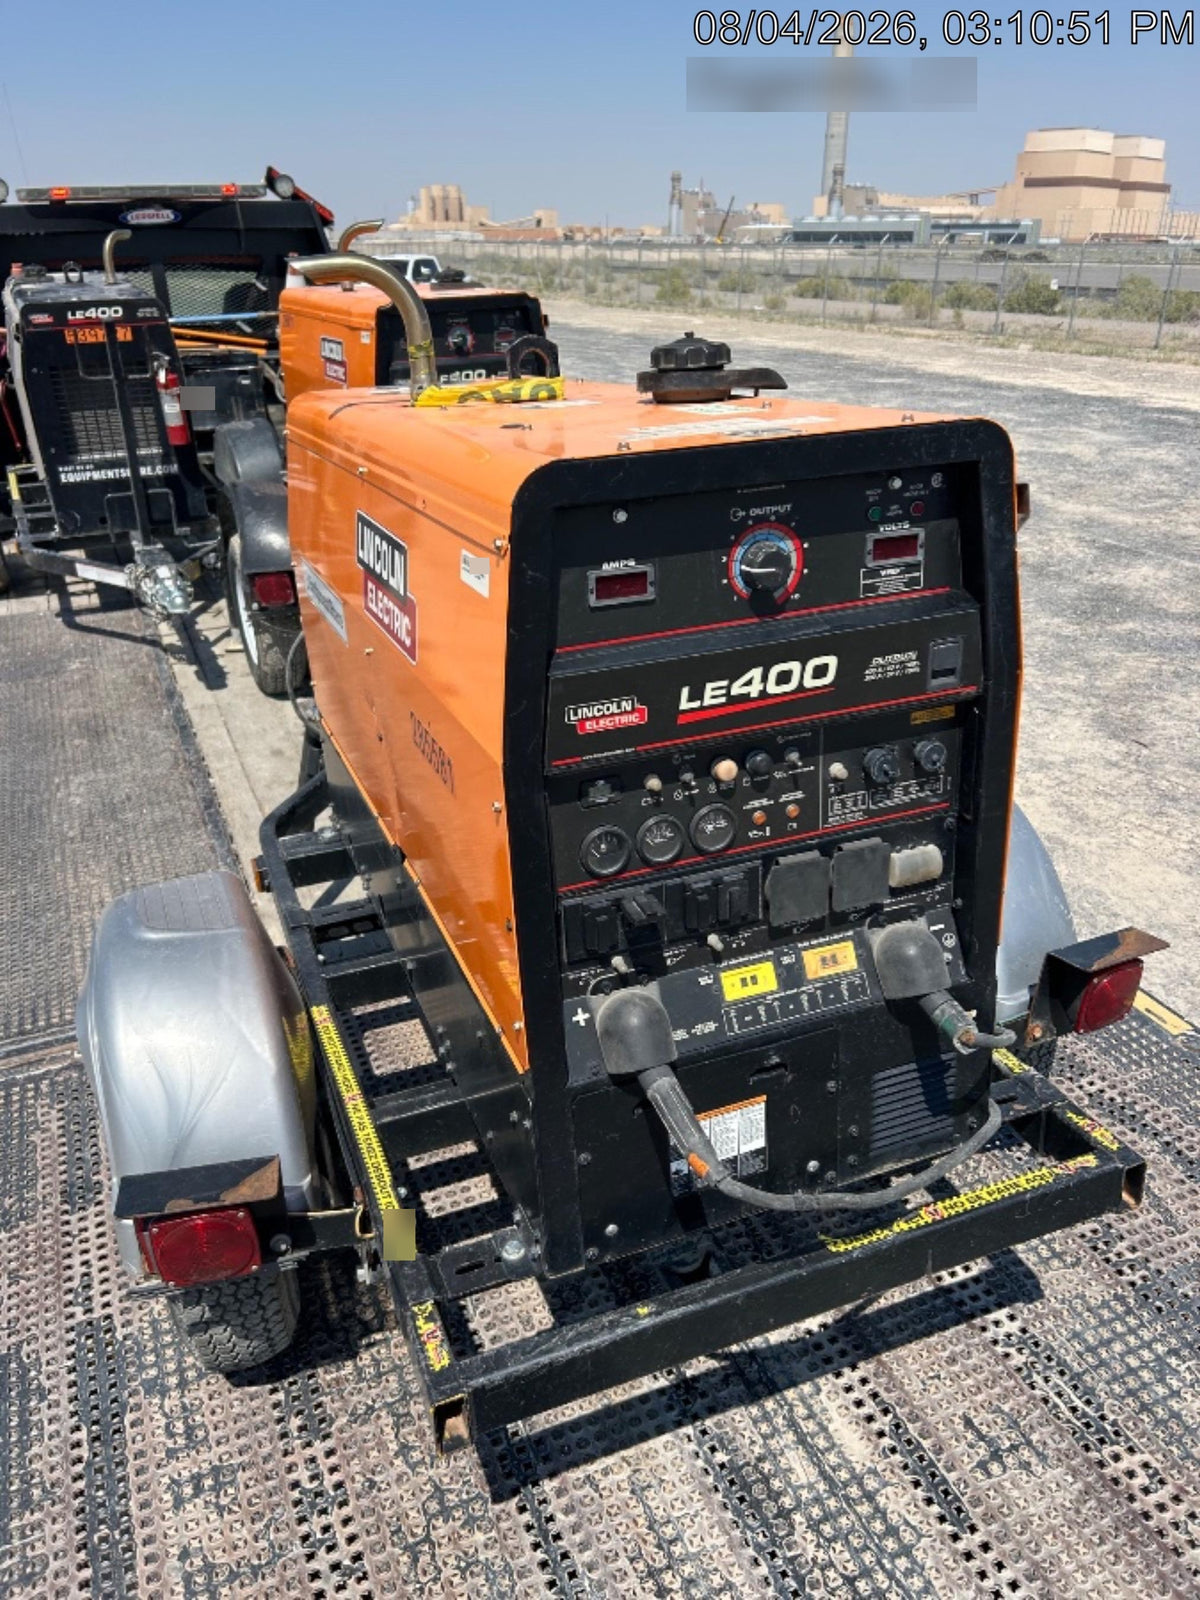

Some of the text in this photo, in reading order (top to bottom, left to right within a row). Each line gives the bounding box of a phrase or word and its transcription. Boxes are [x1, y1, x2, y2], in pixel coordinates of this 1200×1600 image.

[67, 306, 123, 319] LE400
[750, 503, 792, 516] OUTPUT
[358, 521, 405, 596] LINCOLN
[602, 558, 636, 570] AMPS
[367, 579, 412, 648] ELECTRIC
[679, 655, 838, 710] LE400
[569, 699, 632, 721] LINCOLN
[585, 712, 640, 730] ELECTRIC
